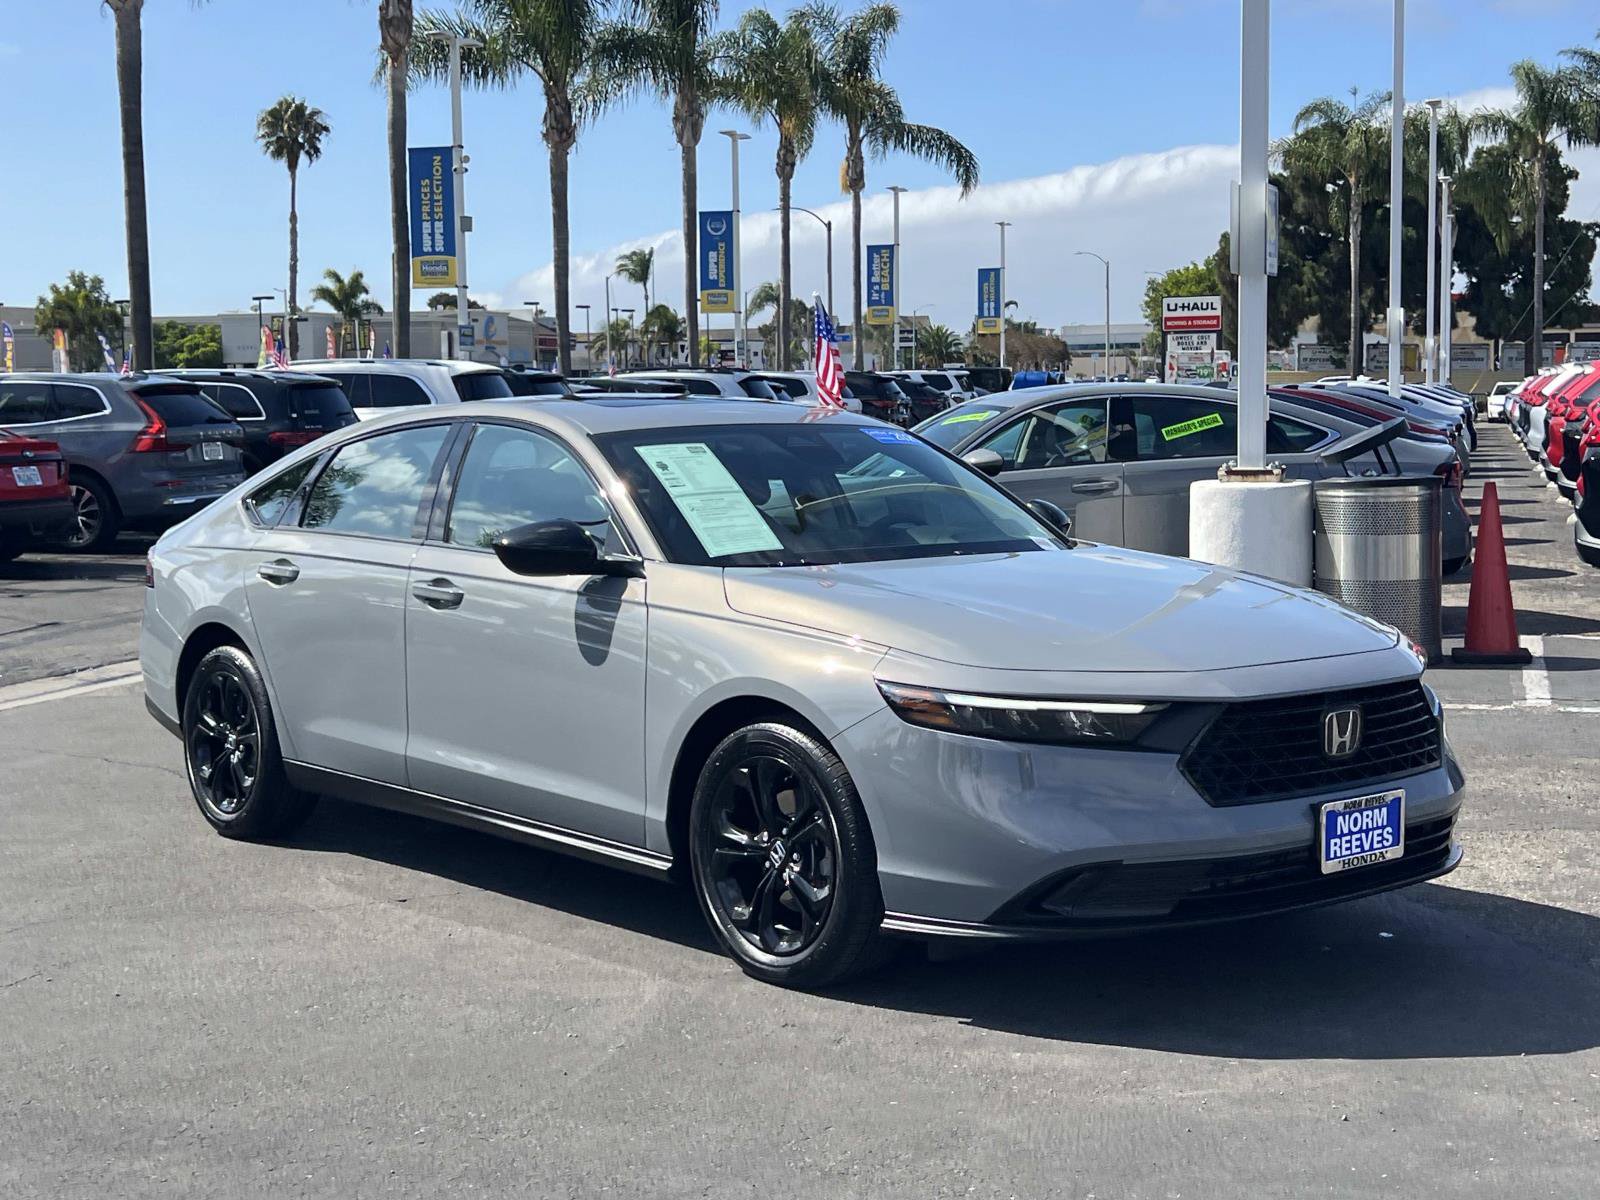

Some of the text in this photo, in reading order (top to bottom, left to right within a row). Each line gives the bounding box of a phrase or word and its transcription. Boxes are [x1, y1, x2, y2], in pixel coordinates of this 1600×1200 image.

[421, 179, 432, 252] SUPER PRICES
[433, 155, 444, 252] SUPER SELECTION
[422, 264, 448, 272] Honda
[709, 251, 717, 280] SUPER
[718, 242, 726, 287] EXPERIENCE
[871, 253, 880, 300] It's Better
[881, 249, 889, 290] BEACH!
[1166, 302, 1218, 311] U-HAUL
[1164, 415, 1221, 438] MANAGER'S SPECIAL
[1337, 807, 1387, 835] NORM
[1330, 826, 1393, 859] REEVES
